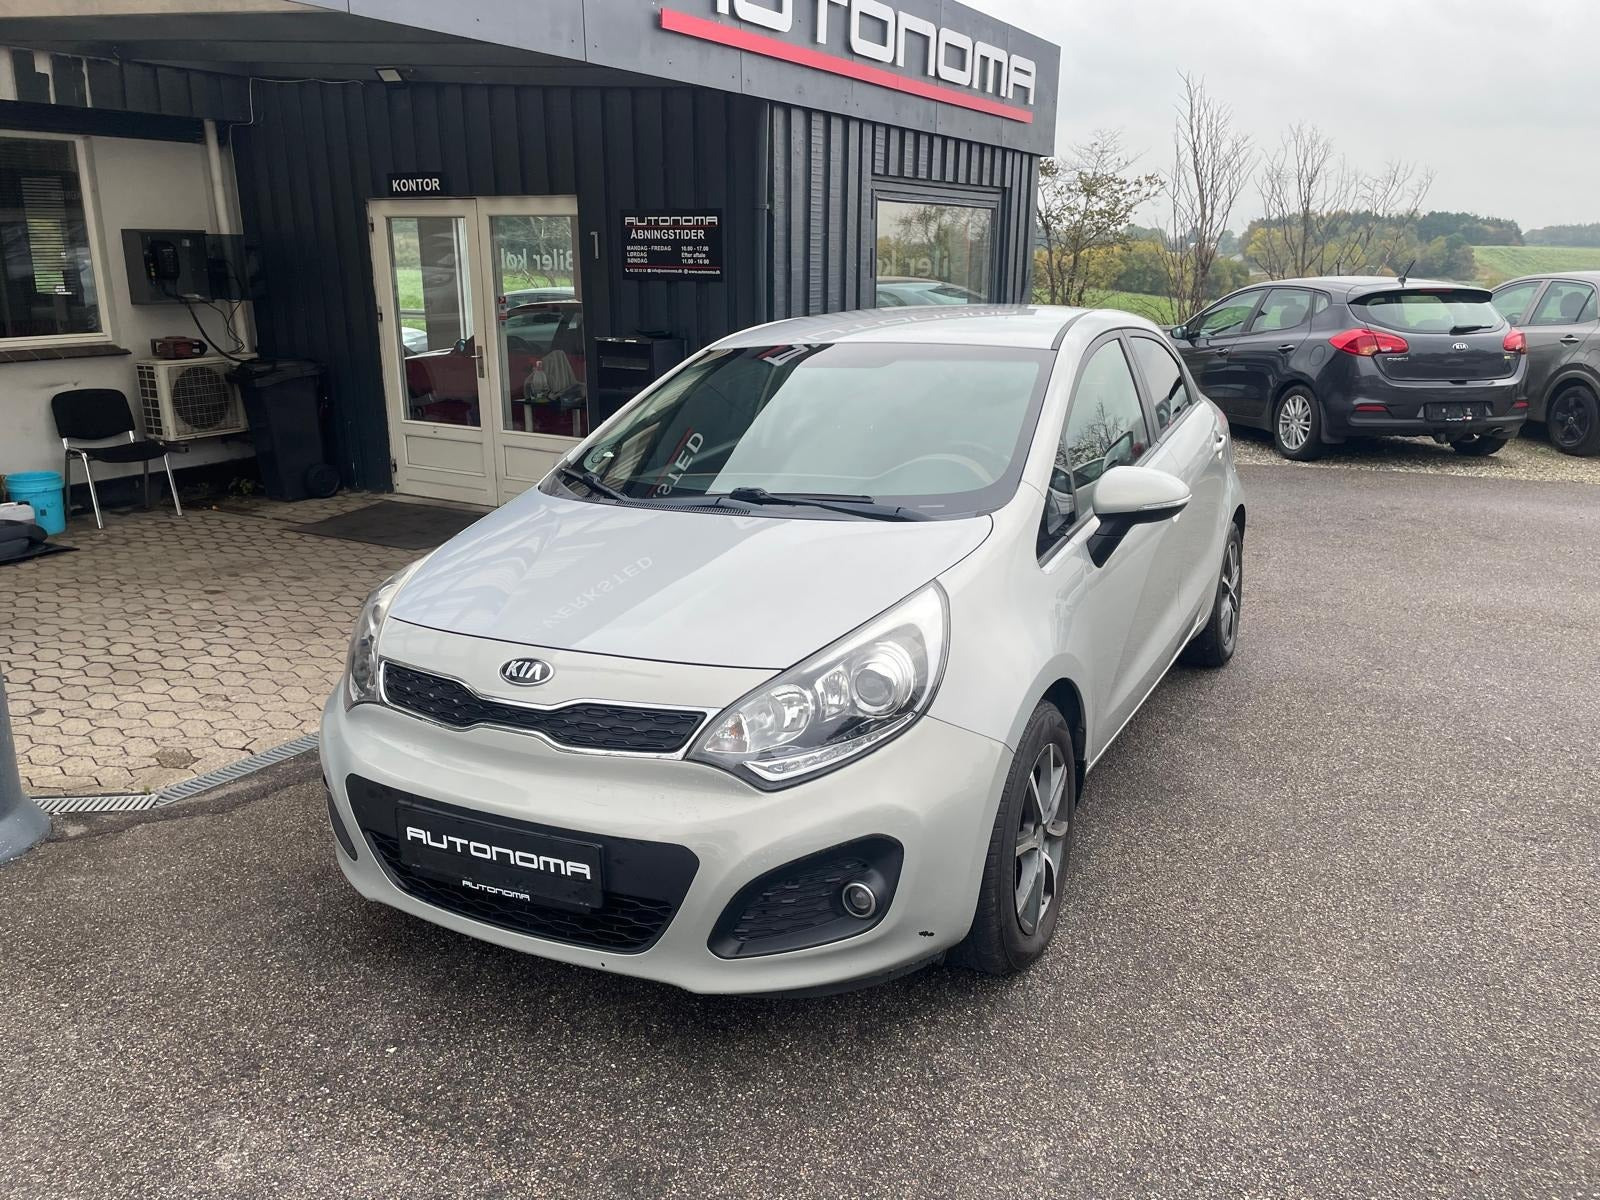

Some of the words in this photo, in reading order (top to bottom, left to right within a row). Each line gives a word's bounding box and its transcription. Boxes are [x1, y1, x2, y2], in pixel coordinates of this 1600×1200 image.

[716, 0, 1037, 105] UTONOMA
[392, 178, 440, 192] KONTOR
[624, 216, 718, 226] AUTONOMA
[630, 228, 705, 240] ÅBNINGSTIDER
[505, 660, 543, 681] KIA
[406, 826, 592, 880] AUTONOMA
[461, 879, 531, 902] AUTONOMA
